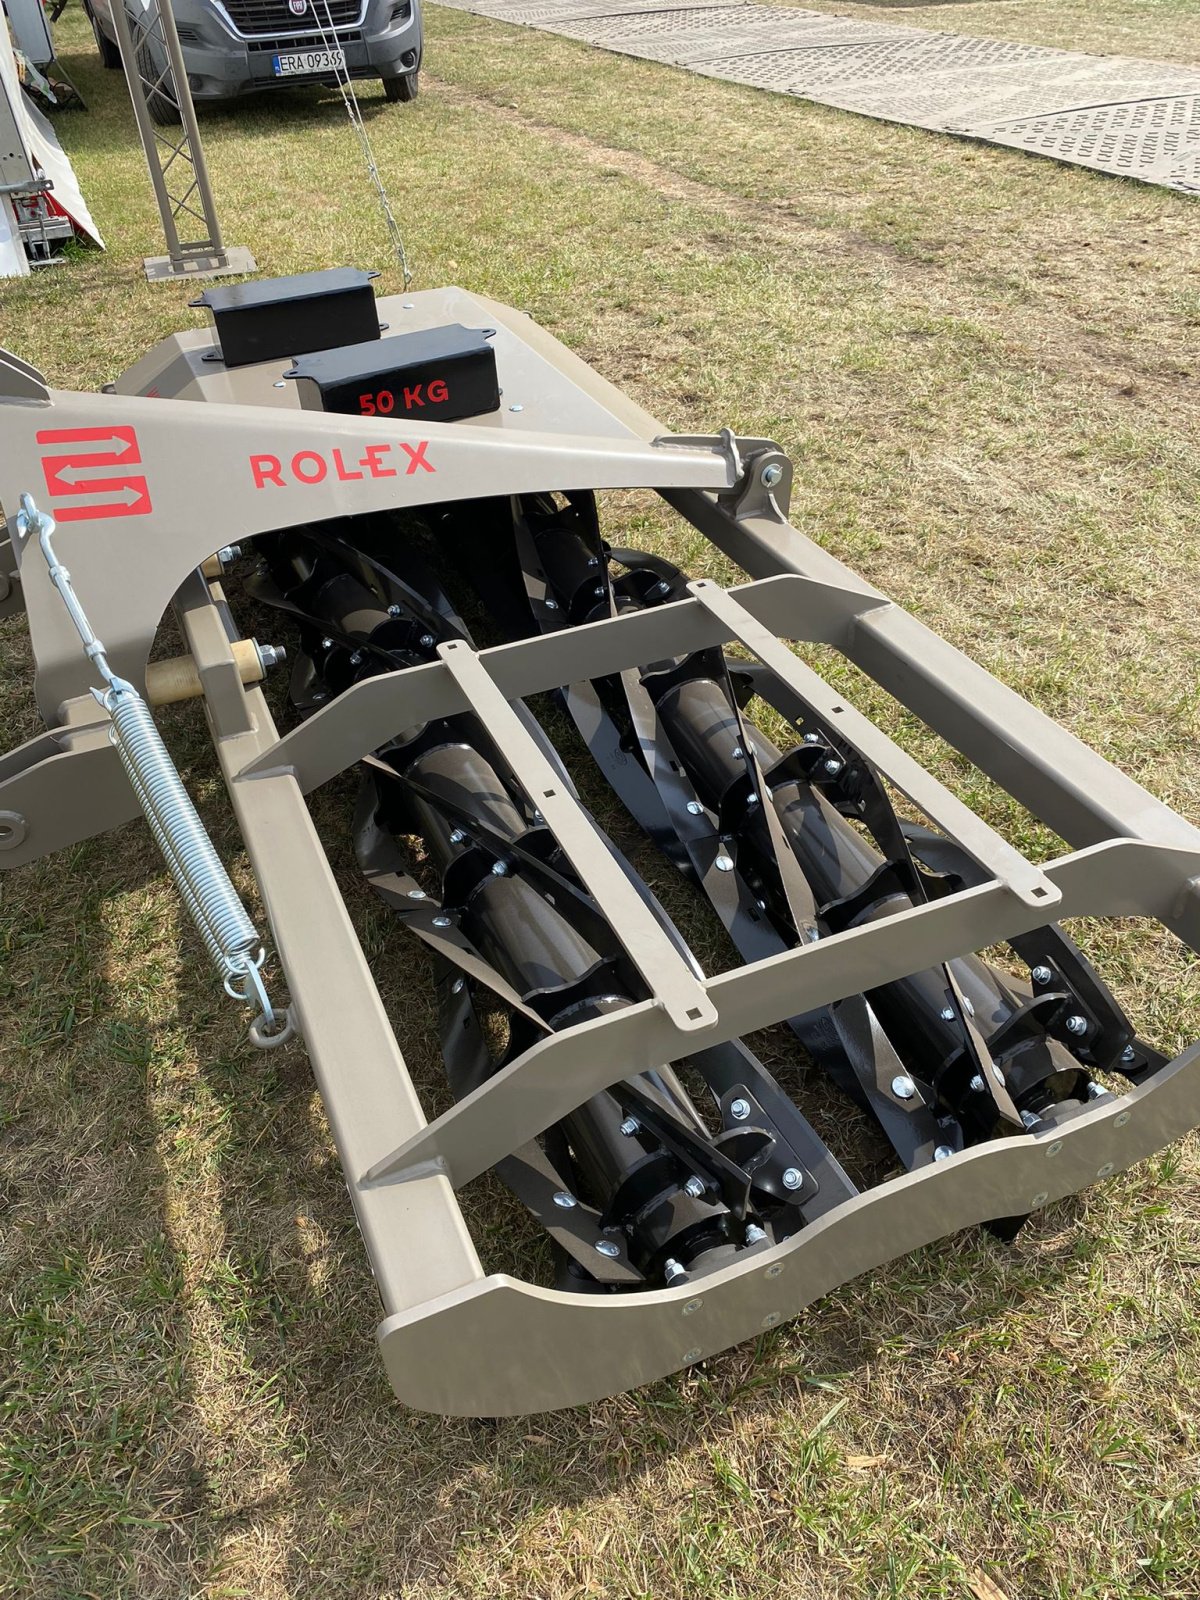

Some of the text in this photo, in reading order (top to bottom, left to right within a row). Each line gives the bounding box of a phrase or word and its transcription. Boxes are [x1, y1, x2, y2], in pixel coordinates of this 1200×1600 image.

[280, 51, 343, 71] ERA 09369
[359, 380, 449, 416] 50 KG
[249, 441, 437, 489] ROLEX
